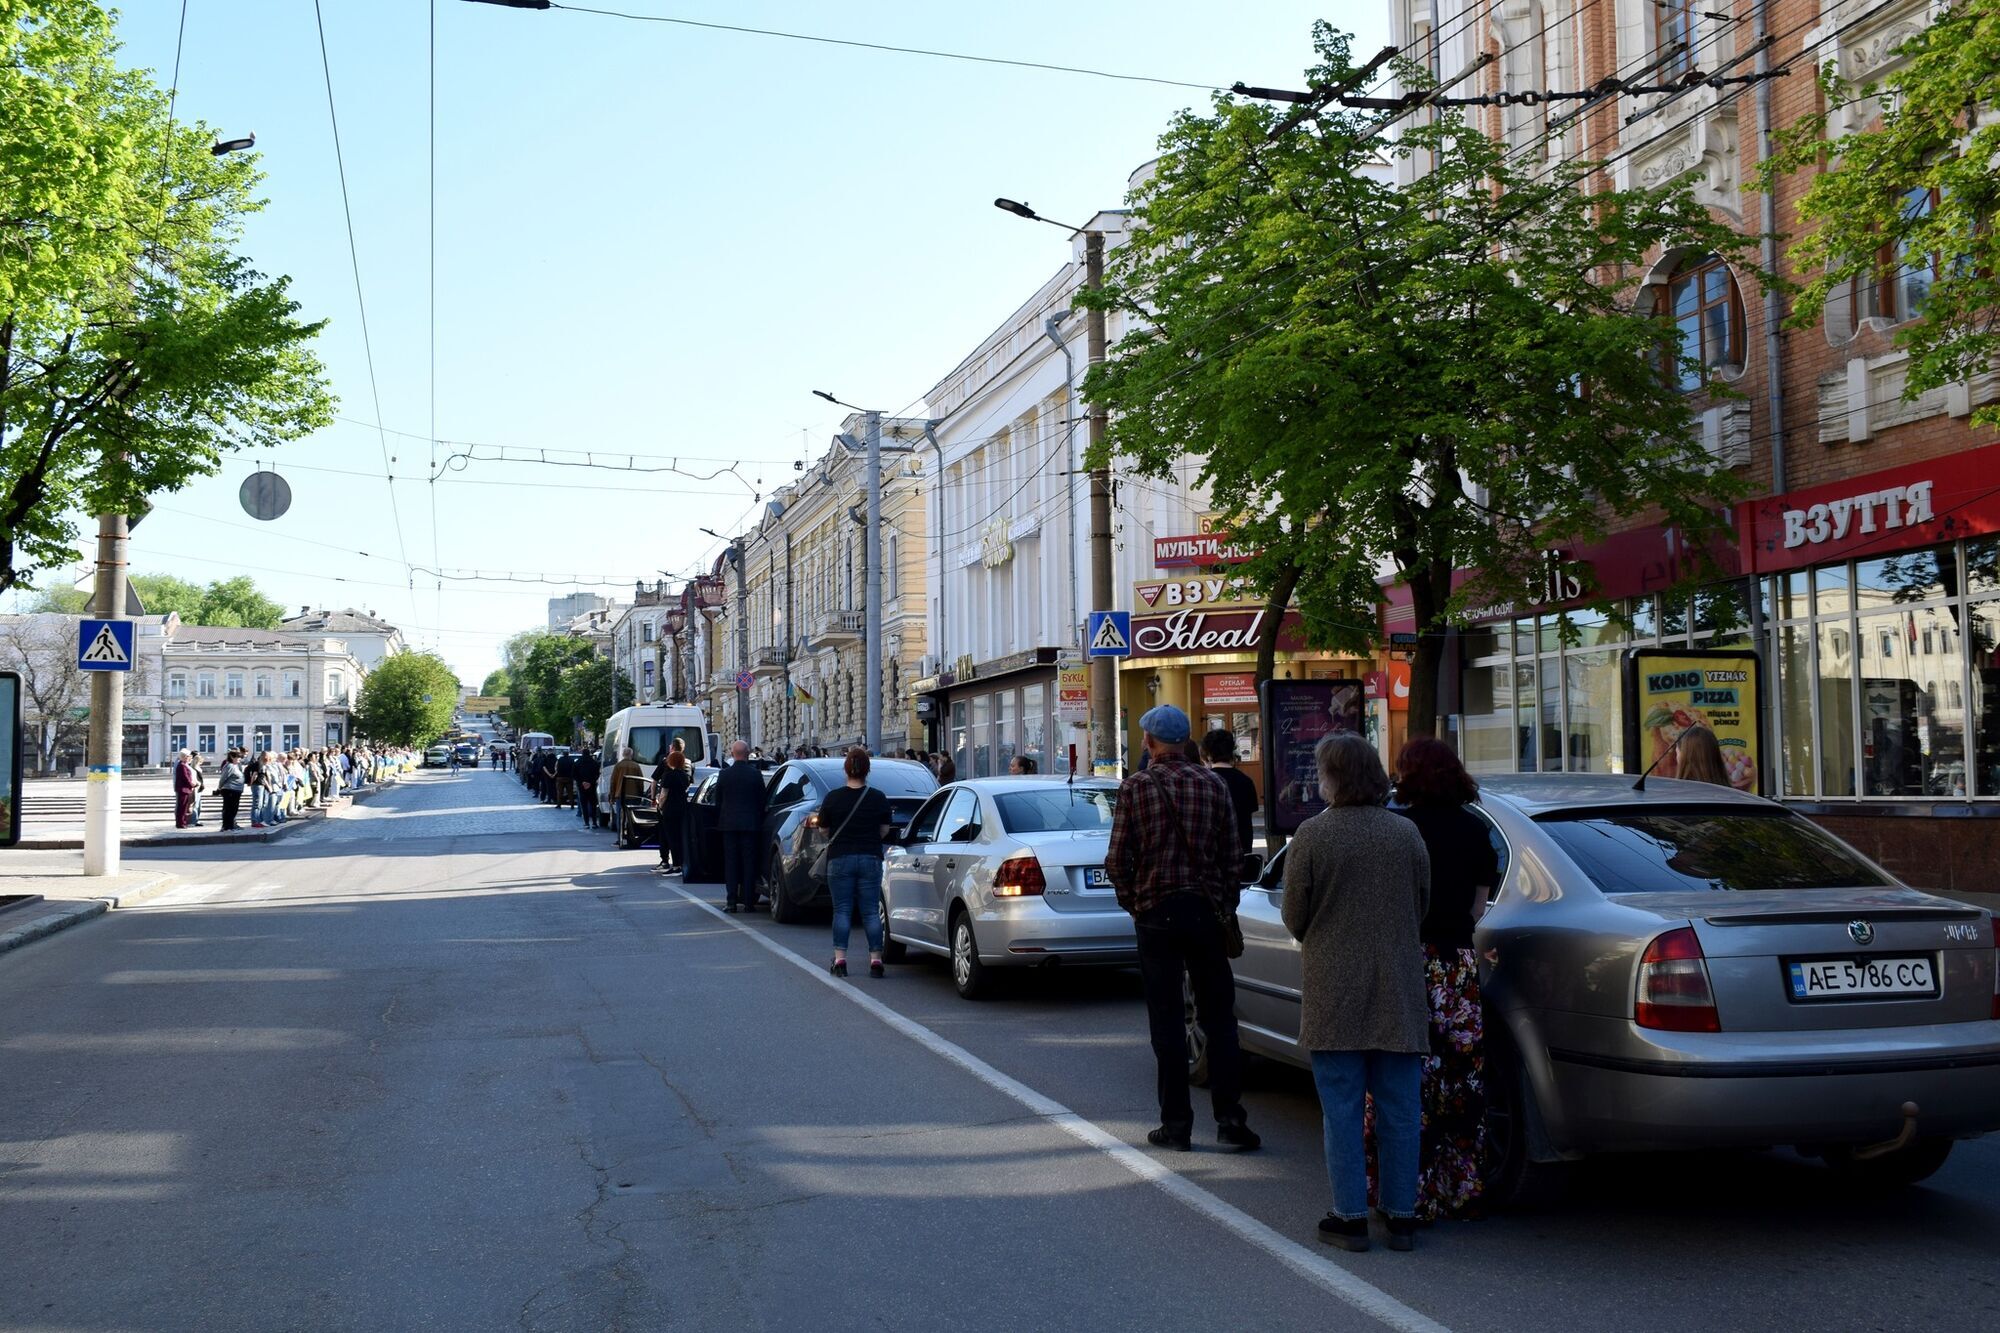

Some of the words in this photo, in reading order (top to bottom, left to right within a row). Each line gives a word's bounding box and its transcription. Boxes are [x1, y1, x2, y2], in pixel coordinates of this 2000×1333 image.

[1783, 480, 1935, 549] ВЗУТТЯ
[1135, 608, 1265, 652] Ideal
[1648, 672, 1700, 691] KONO
[1705, 671, 1747, 682] YIZHAK
[1693, 691, 1736, 703] PIZZA
[1808, 966, 1840, 991] AE
[1844, 964, 1893, 989] 5786
[1896, 963, 1927, 987] CC
